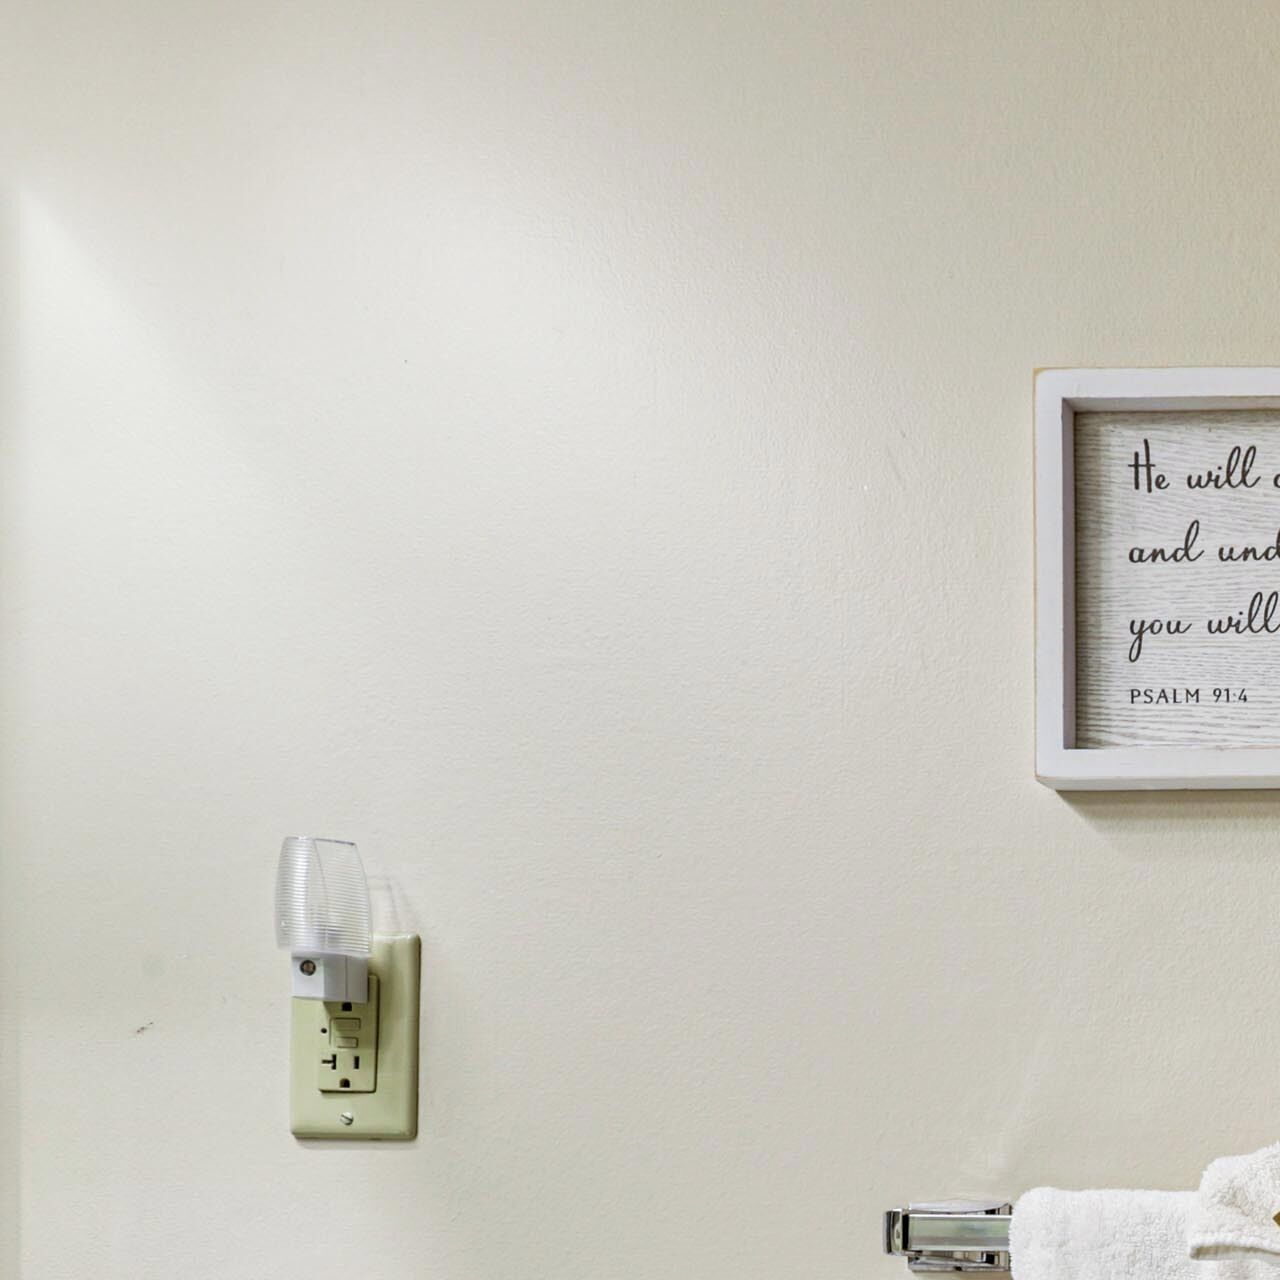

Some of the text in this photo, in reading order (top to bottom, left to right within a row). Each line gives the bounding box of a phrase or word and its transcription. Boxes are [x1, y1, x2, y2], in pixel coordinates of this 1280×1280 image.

[1127, 438, 1170, 494] He
[1186, 445, 1261, 491] will
[1127, 518, 1206, 565] and
[1128, 618, 1194, 663] you
[1129, 687, 1201, 705] PSALM
